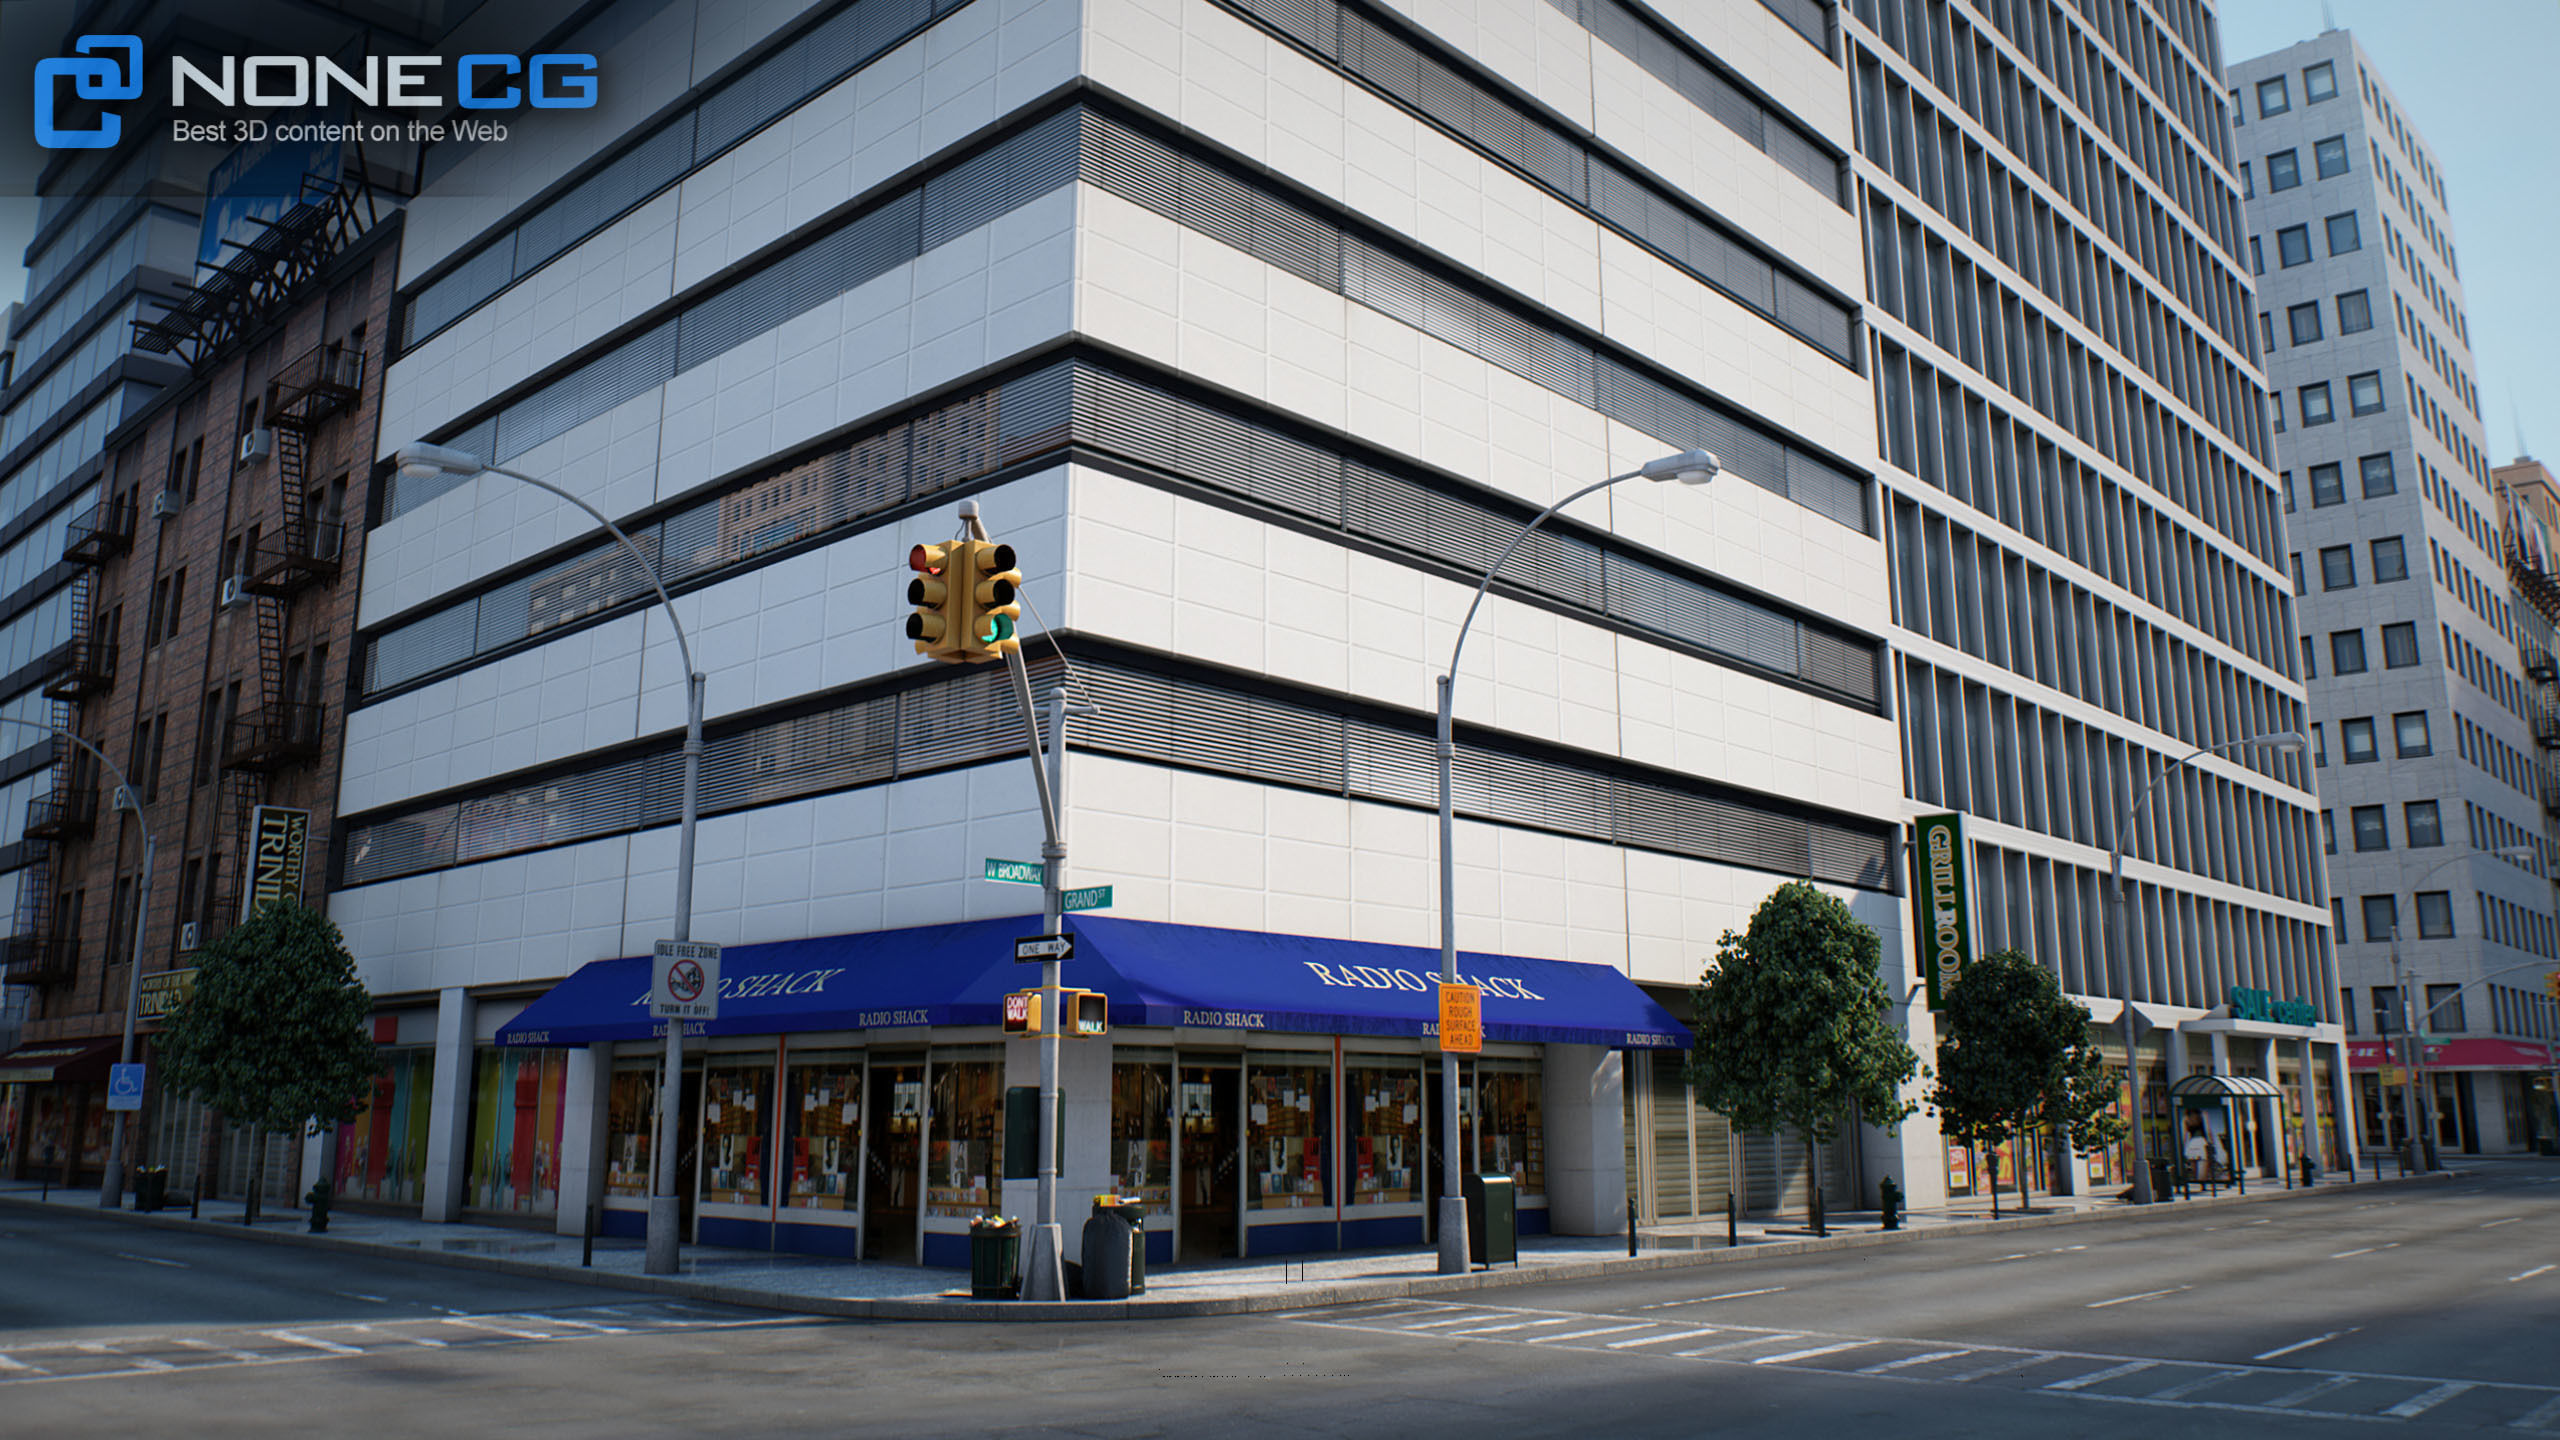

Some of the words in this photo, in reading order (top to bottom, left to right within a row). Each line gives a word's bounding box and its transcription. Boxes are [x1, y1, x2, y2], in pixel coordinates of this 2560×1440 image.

[286, 815, 306, 888] WORTHY
[254, 813, 289, 919] TRINID
[987, 862, 997, 878] W
[998, 863, 1042, 882] BROADWAY
[1065, 890, 1098, 909] GRAND
[1098, 888, 1106, 899] ST
[656, 944, 674, 957] IDLE
[677, 945, 696, 958] FREE
[698, 946, 718, 959] ZONE
[1022, 944, 1041, 956] ONE
[1047, 942, 1066, 953] WAY
[722, 967, 846, 999] SHACK
[1301, 961, 1428, 992] RADIO
[1426, 970, 1546, 1001] SACK
[1445, 991, 1475, 1003] CAUTION
[2232, 985, 2275, 1022] SALE
[660, 1003, 681, 1014] TURN
[683, 1005, 691, 1014] IT
[1007, 1008, 1028, 1020] WALK
[1448, 1005, 1473, 1017] ROUGH
[858, 1011, 892, 1026] RADIO
[893, 1009, 929, 1024] SHACK
[1183, 1009, 1223, 1026] RADIO
[1224, 1011, 1265, 1028] SHACK
[683, 1021, 706, 1035] HACK
[1078, 1019, 1103, 1032] WALK
[1446, 1019, 1476, 1032] SURFACE
[507, 1031, 527, 1045] RADIO
[528, 1030, 550, 1044] SHACK
[1450, 1032, 1474, 1045] AHEAD
[1626, 1033, 1651, 1046] RADIO
[1651, 1034, 1677, 1047] SHACK
